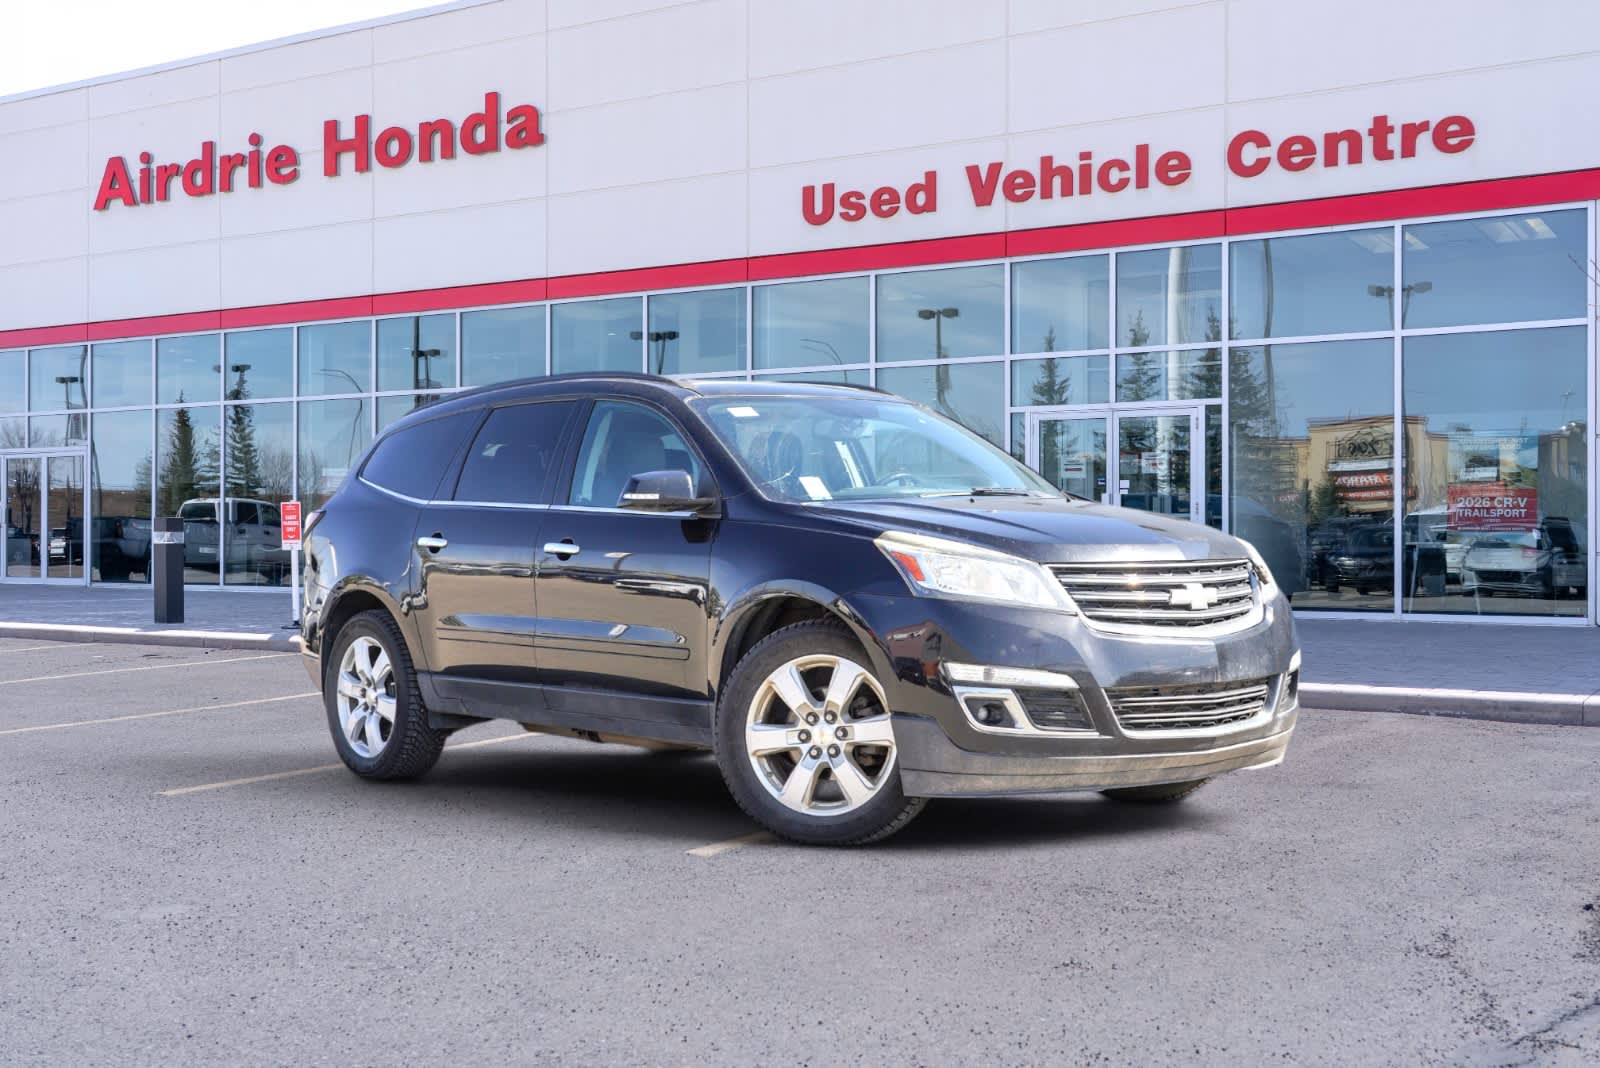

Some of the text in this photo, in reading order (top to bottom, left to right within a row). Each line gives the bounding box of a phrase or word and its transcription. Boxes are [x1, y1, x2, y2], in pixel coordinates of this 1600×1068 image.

[94, 91, 545, 210] Airdrie Honda
[802, 115, 1476, 225] Used Vehicle Centre
[1456, 497, 1527, 508] 2026 CR-V
[1459, 508, 1528, 518] TRAILSPORT
